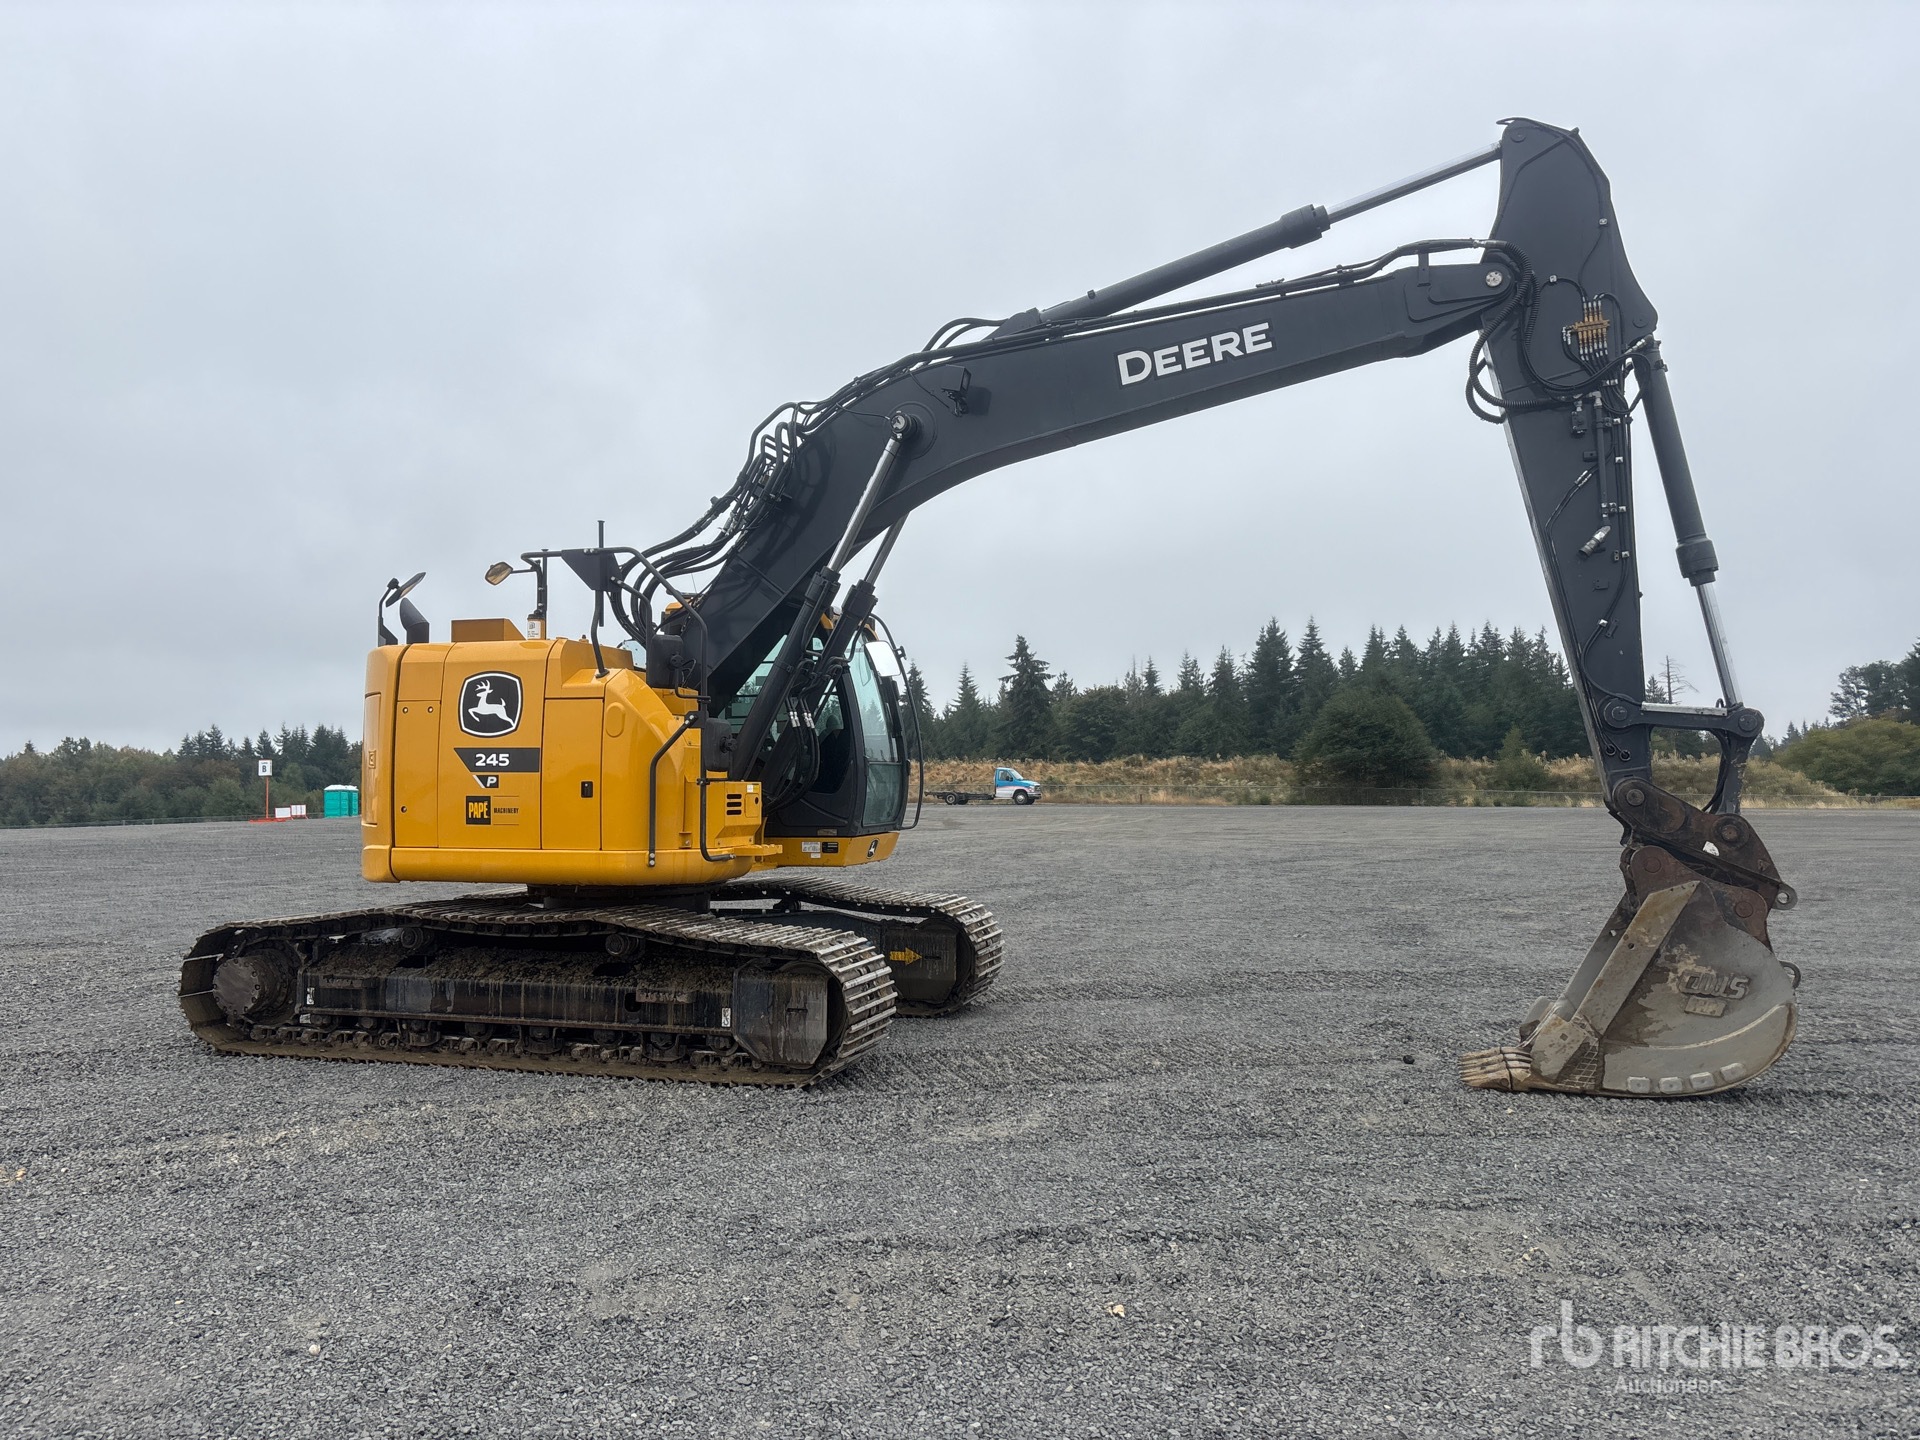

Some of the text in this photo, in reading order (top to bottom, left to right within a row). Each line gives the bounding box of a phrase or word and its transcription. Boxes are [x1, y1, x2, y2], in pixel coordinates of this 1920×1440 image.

[1117, 322, 1273, 386] DEERE
[475, 753, 510, 767] 245
[486, 776, 497, 787] P
